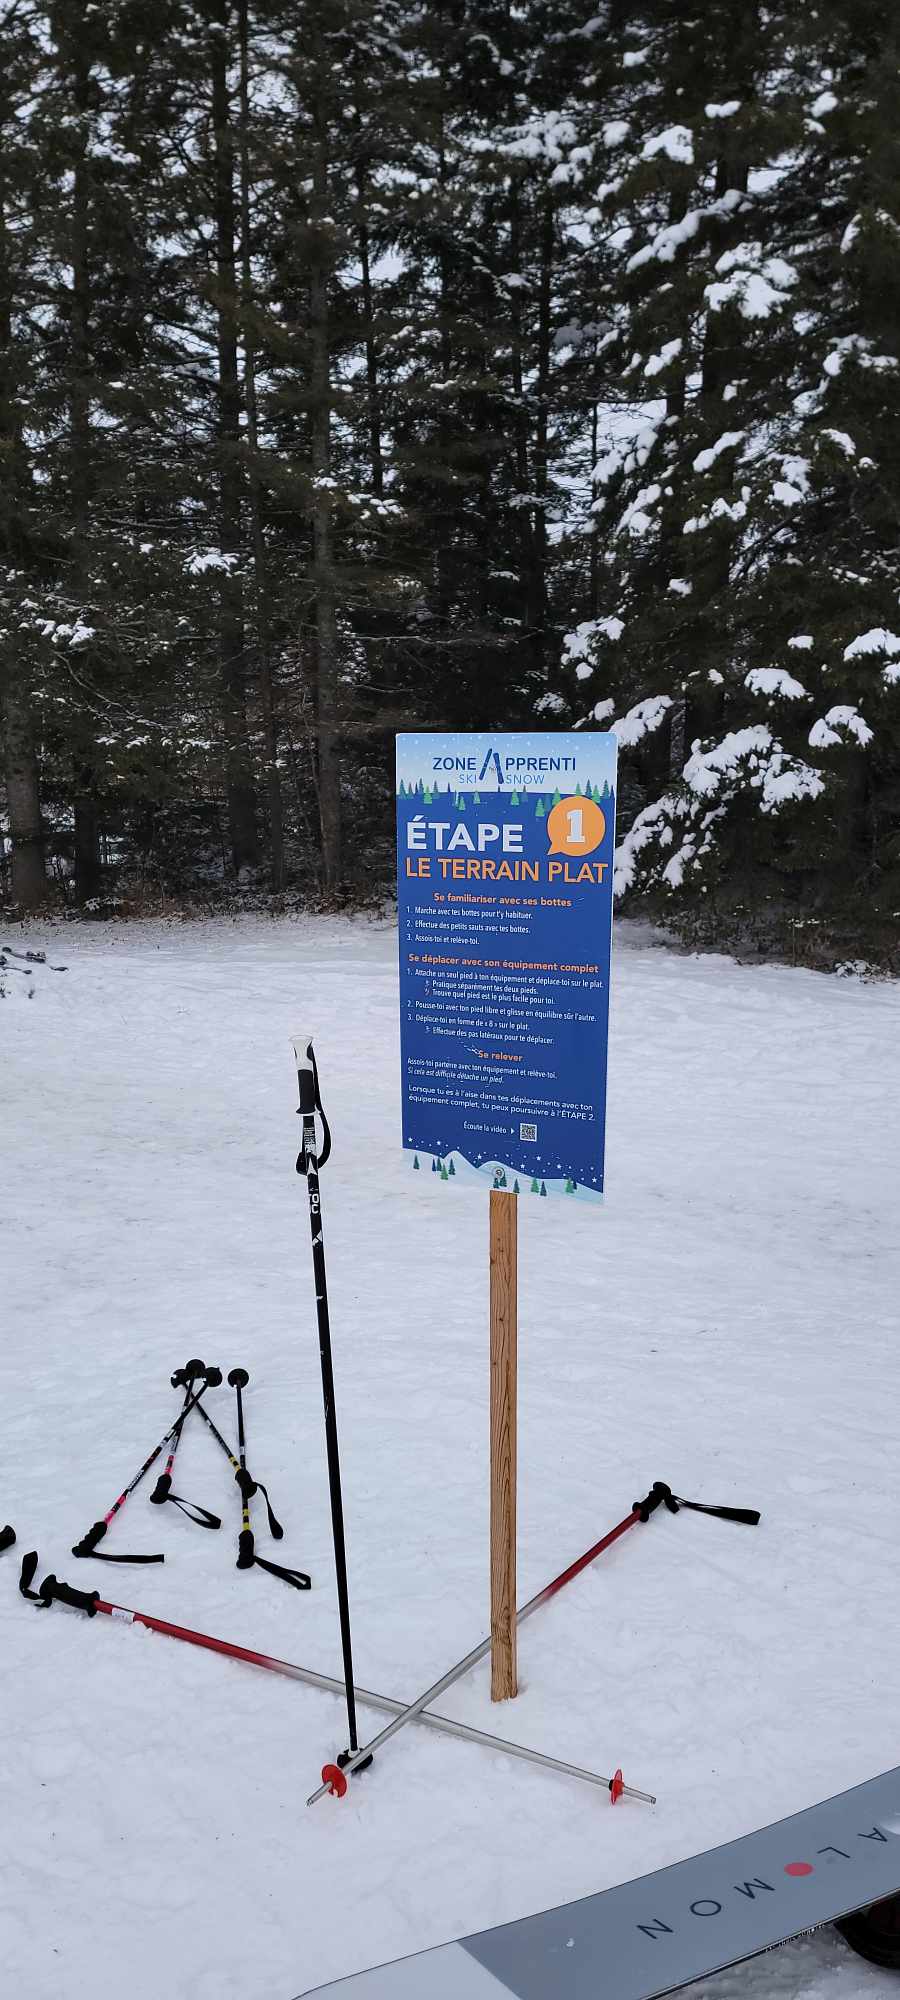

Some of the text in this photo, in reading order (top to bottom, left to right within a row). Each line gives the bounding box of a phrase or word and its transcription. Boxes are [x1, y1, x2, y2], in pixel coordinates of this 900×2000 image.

[433, 757, 476, 770] ZONE
[459, 775, 544, 784] SKI SNOW
[407, 809, 585, 852] ÉTAPE 1
[406, 857, 608, 883] LE TERRAIN PLAT
[448, 893, 496, 903] familiariser
[541, 897, 572, 906] bottes
[462, 908, 480, 916] bottes
[481, 910, 495, 918] pour
[506, 910, 532, 919] habituer.
[415, 920, 437, 928] Effectue
[451, 923, 467, 931] petits
[415, 934, 442, 942] Assois-toi
[422, 955, 458, 964] déplacer
[503, 960, 558, 970] équipement
[560, 964, 598, 973] complet
[432, 980, 456, 989] Pratique
[460, 971, 472, 980] pied
[490, 974, 527, 983] équipement
[536, 977, 570, 986] déplace-toi
[590, 981, 603, 989] plat.
[432, 989, 451, 997] Trouve
[453, 990, 465, 999] quel
[499, 994, 511, 1002] plus
[513, 994, 528, 1002] facile
[415, 1001, 444, 1009] Pousse-toi
[471, 1005, 483, 1013] pied
[485, 1005, 498, 1013] libre
[507, 1008, 524, 1016] glisse
[535, 1011, 562, 1020] équilibre
[575, 1013, 596, 1021] l'autre.
[416, 1014, 447, 1023] Déplace-toi
[458, 1017, 474, 1026] forme
[517, 1023, 529, 1031] plat.
[433, 1027, 455, 1036] Effectue
[480, 1030, 502, 1039] latéraux
[505, 1034, 518, 1042] pour
[479, 1050, 523, 1061] Se relever
[435, 1061, 457, 1069] parterre
[483, 1065, 519, 1075] équipement
[528, 1070, 557, 1079] relève-toi.
[490, 1076, 503, 1084] pied.
[409, 1085, 435, 1094] Lorsque
[461, 1090, 478, 1098] l'aise
[480, 1092, 496, 1100] dans
[511, 1096, 560, 1107] déplacements
[580, 1103, 592, 1111] ton
[409, 1094, 449, 1103] équipement
[451, 1099, 480, 1108] complet,
[492, 1104, 509, 1112] peux
[511, 1106, 548, 1115] poursuivre
[557, 1110, 586, 1120] l'ÉTAPE
[464, 1121, 483, 1130] Écoute
[491, 1124, 506, 1133] vidéo
